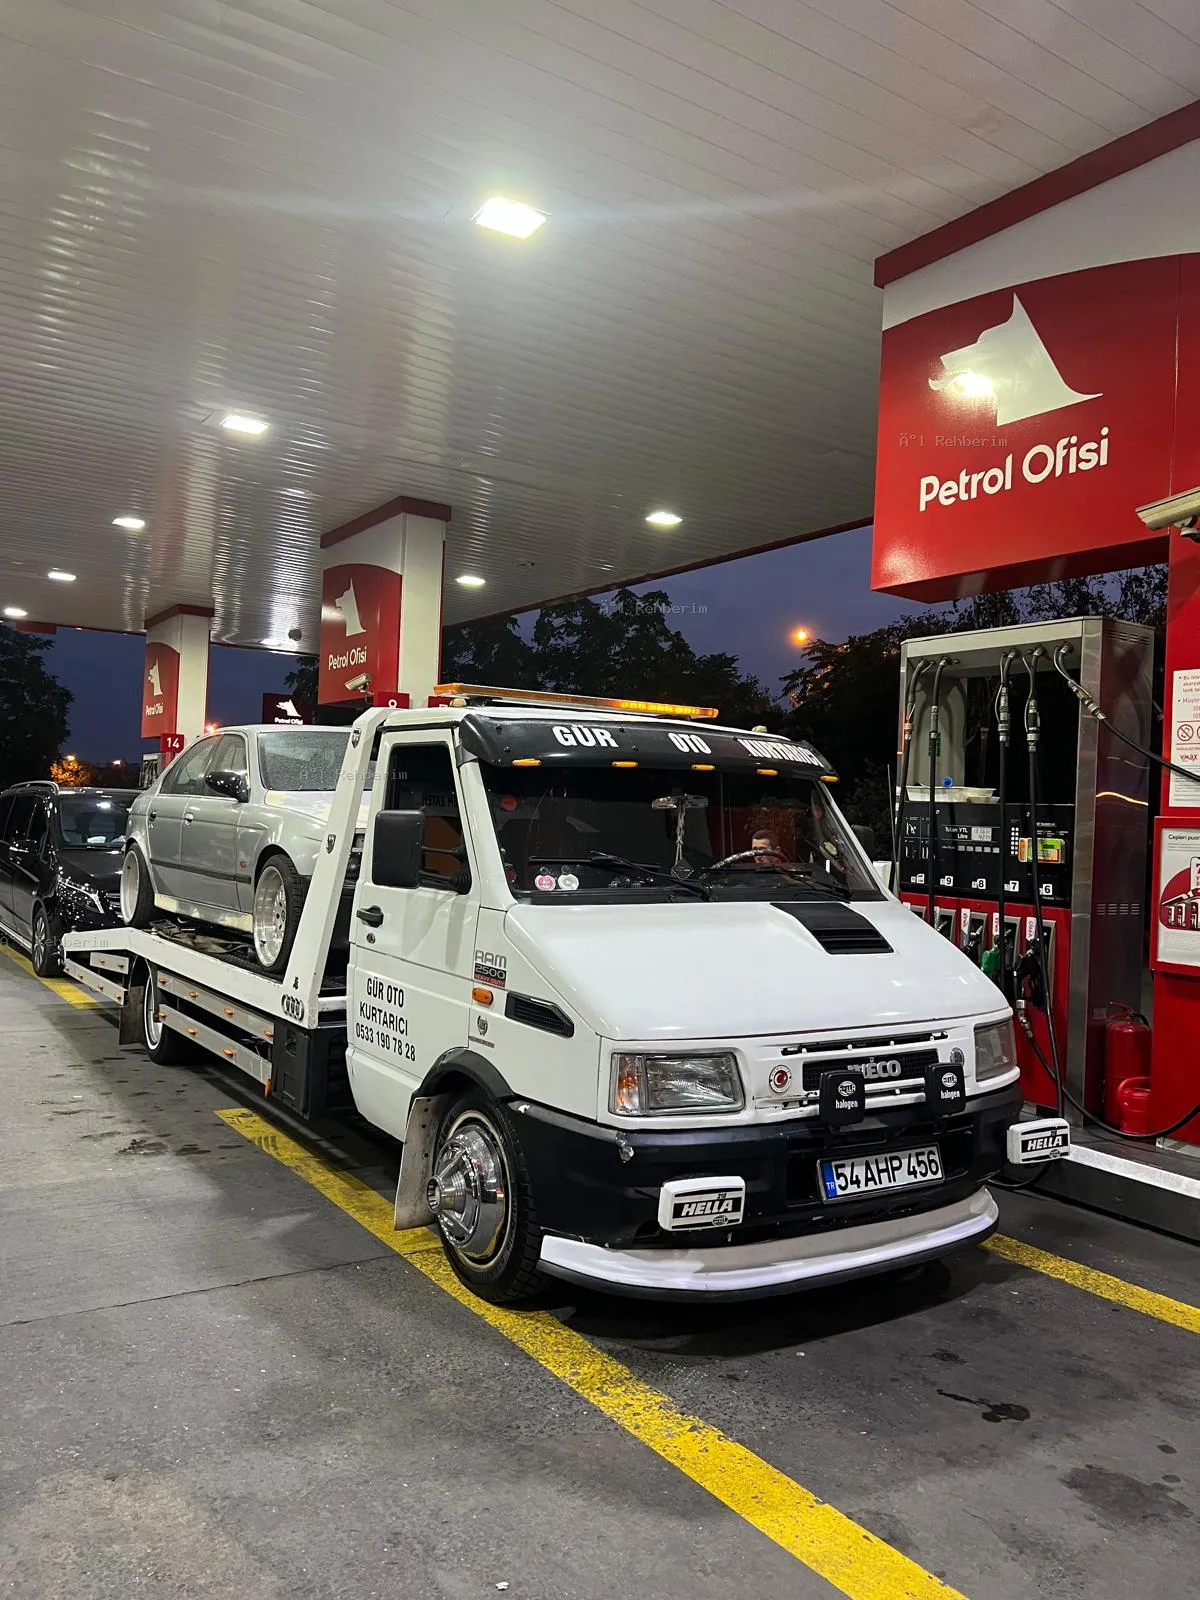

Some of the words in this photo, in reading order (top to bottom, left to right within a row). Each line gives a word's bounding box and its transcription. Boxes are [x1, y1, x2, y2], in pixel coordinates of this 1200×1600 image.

[919, 453, 1013, 512] Petrol
[1021, 426, 1110, 484] Ofisi
[328, 651, 349, 670] Petrol
[350, 645, 367, 666] Ofisi
[166, 737, 180, 749] 14
[552, 724, 619, 748] GÜR
[667, 732, 712, 754] OTO
[737, 738, 825, 768] KURTARICI
[946, 876, 952, 885] 9
[978, 879, 985, 888] 8
[1010, 882, 1017, 891] 7
[1044, 885, 1051, 894] 6
[475, 949, 507, 969] RAM
[475, 964, 506, 979] 2500
[490, 977, 505, 987] DUTY
[366, 976, 384, 1001] GÜR
[386, 984, 405, 1008] OTO
[359, 1001, 408, 1037] KURTARICI
[355, 1022, 374, 1043] 0533
[376, 1030, 391, 1050] 190
[392, 1037, 403, 1056] 78
[405, 1042, 416, 1062] 28
[940, 1089, 961, 1100] halogen
[835, 1099, 859, 1110] halogen
[1027, 1135, 1063, 1151] HELLA
[834, 1161, 862, 1192] 54
[864, 1155, 903, 1188] AHP
[907, 1149, 940, 1179] 456
[826, 1182, 836, 1190] TR
[680, 1199, 733, 1217] HELLA
